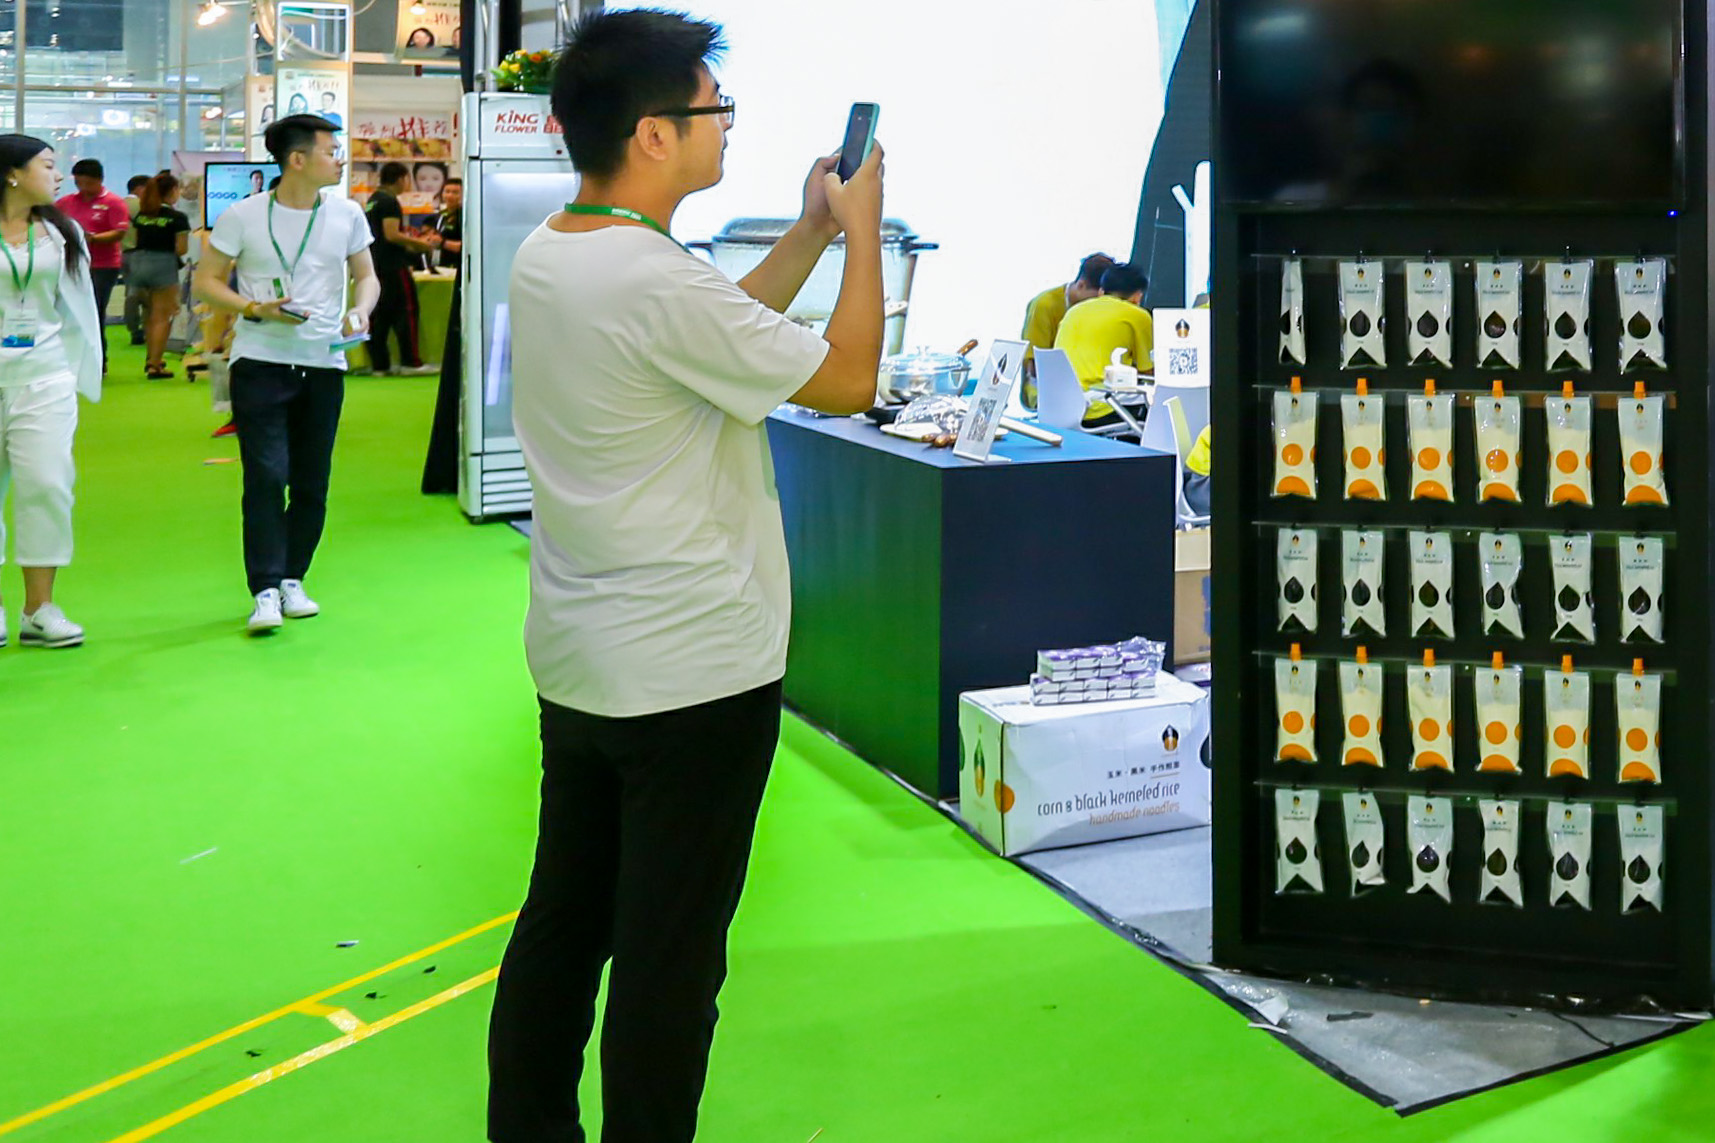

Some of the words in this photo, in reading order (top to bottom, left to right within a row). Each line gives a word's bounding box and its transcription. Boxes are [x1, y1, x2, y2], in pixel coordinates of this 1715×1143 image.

[496, 110, 539, 124] KING
[494, 125, 538, 133] FLOWER
[1037, 800, 1063, 816] corn
[1074, 791, 1107, 811] black
[1109, 781, 1160, 806] kerneled
[1161, 782, 1181, 798] rice
[1089, 806, 1141, 826] handmade
[1142, 799, 1180, 817] noodles
